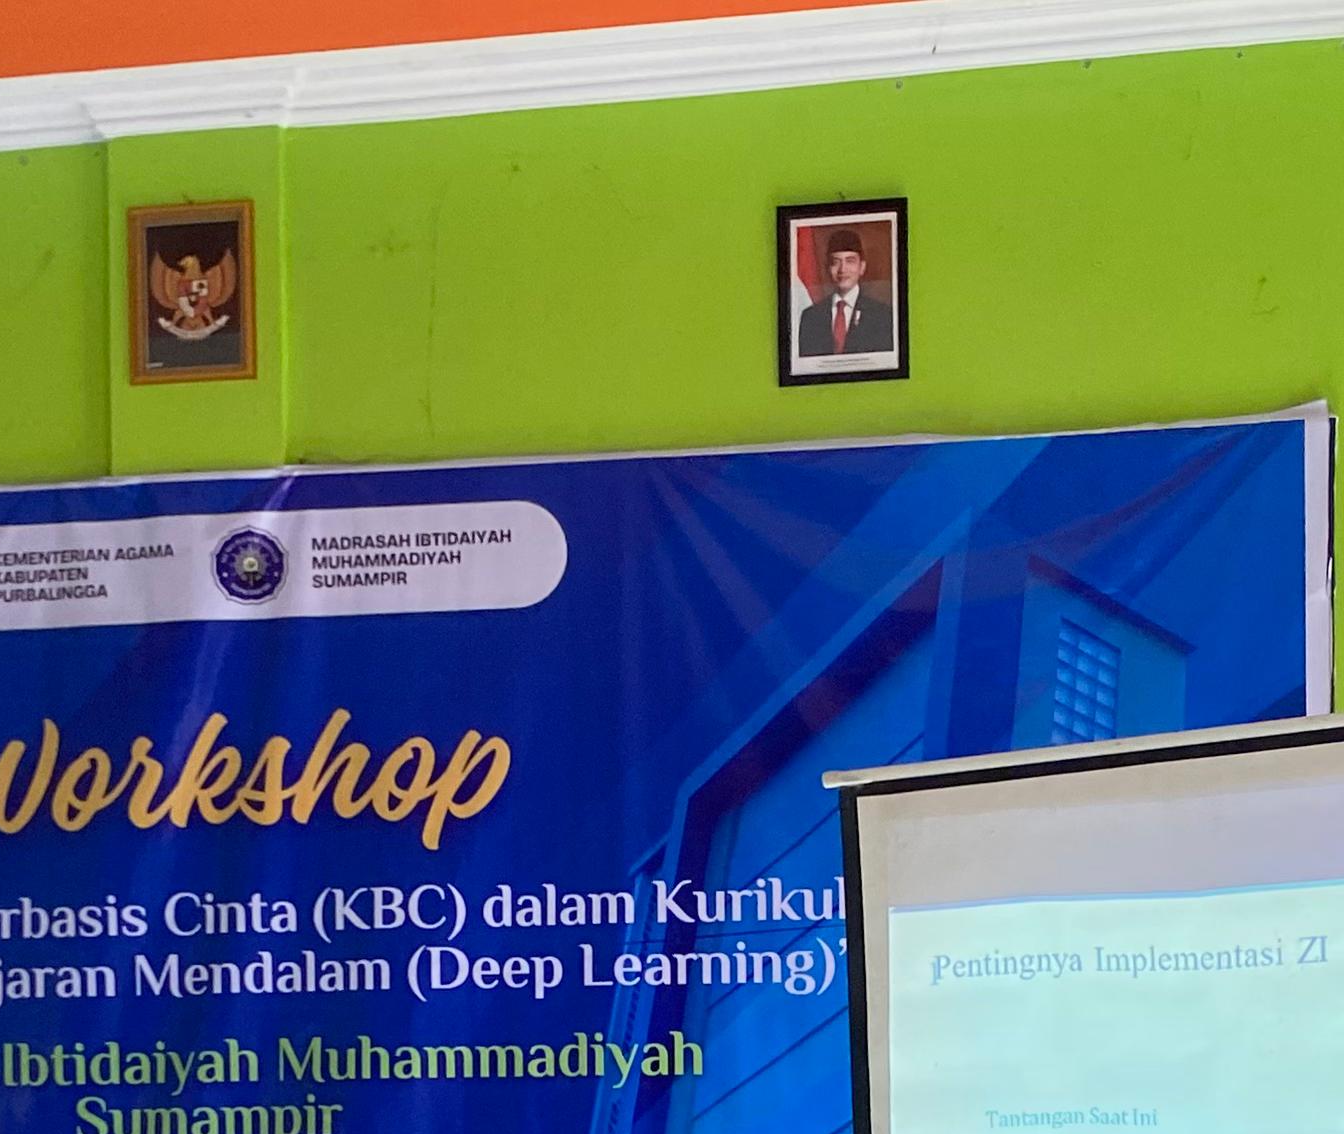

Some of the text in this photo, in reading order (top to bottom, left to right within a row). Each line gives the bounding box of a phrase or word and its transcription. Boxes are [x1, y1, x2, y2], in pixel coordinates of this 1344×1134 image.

[311, 529, 512, 551] MADRASAH IBTIDAIYAH
[114, 544, 175, 561] AGAMA
[312, 550, 461, 569] MUHAMMADIYAH
[312, 571, 408, 588] SUMAMPIR
[164, 891, 298, 937] Cinta
[312, 883, 467, 943] (KBC)
[482, 883, 636, 927] dalam
[652, 876, 846, 923] Kurikul
[931, 935, 1329, 982] Pentingnya Implementasi ZI
[133, 950, 391, 998] Mendalam
[407, 944, 563, 1002] (Deep
[2, 1037, 259, 1096] Ibtidaiyah
[278, 1030, 704, 1088] Muhammadiyah
[984, 1107, 1158, 1128] Tantangan Saat Ini
